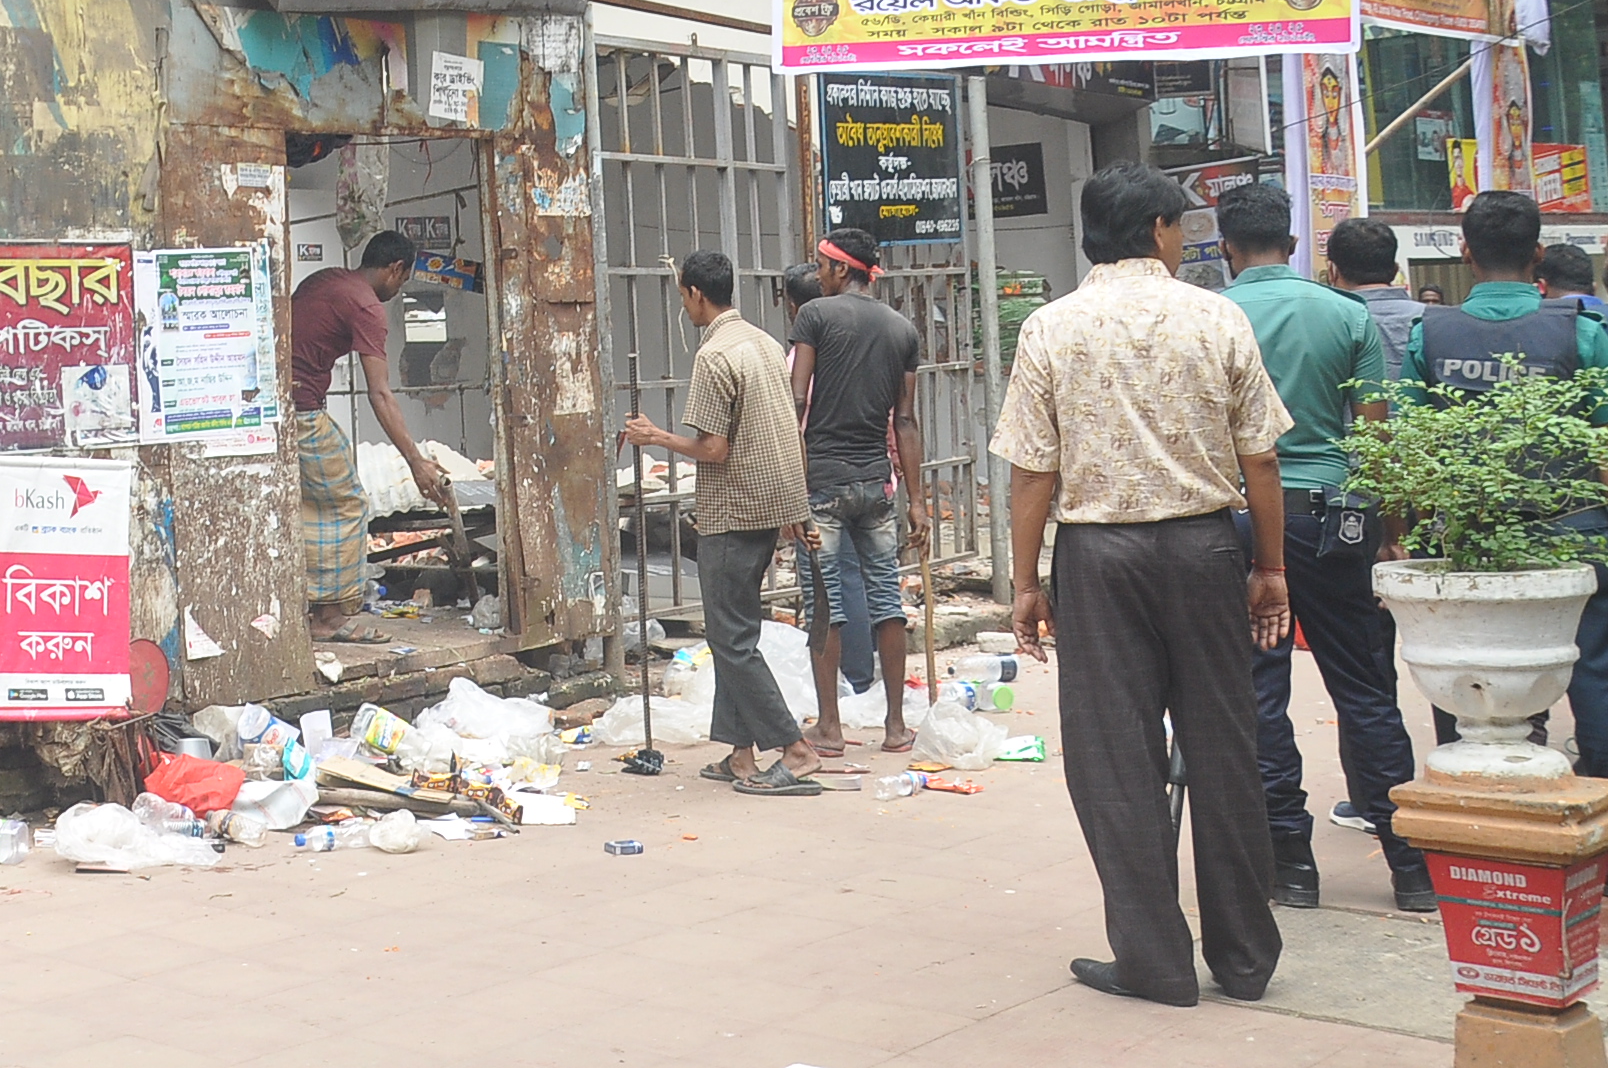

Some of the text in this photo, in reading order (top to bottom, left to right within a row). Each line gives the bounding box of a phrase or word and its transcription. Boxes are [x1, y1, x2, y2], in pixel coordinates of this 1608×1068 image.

[931, 19, 1084, 36] সকাল থেকে
[898, 29, 1181, 57] সকলেই আমন্ত্রিত
[836, 112, 865, 147] অবৈধ
[1413, 231, 1454, 247] SAMSUNG
[14, 487, 65, 510] bKash
[1, 564, 115, 617] বিকাশ
[17, 630, 95, 662] করুন
[1449, 865, 1527, 888] DIAMOND
[1482, 884, 1552, 905] Extreme
[1471, 925, 1518, 950] গ্রেড
